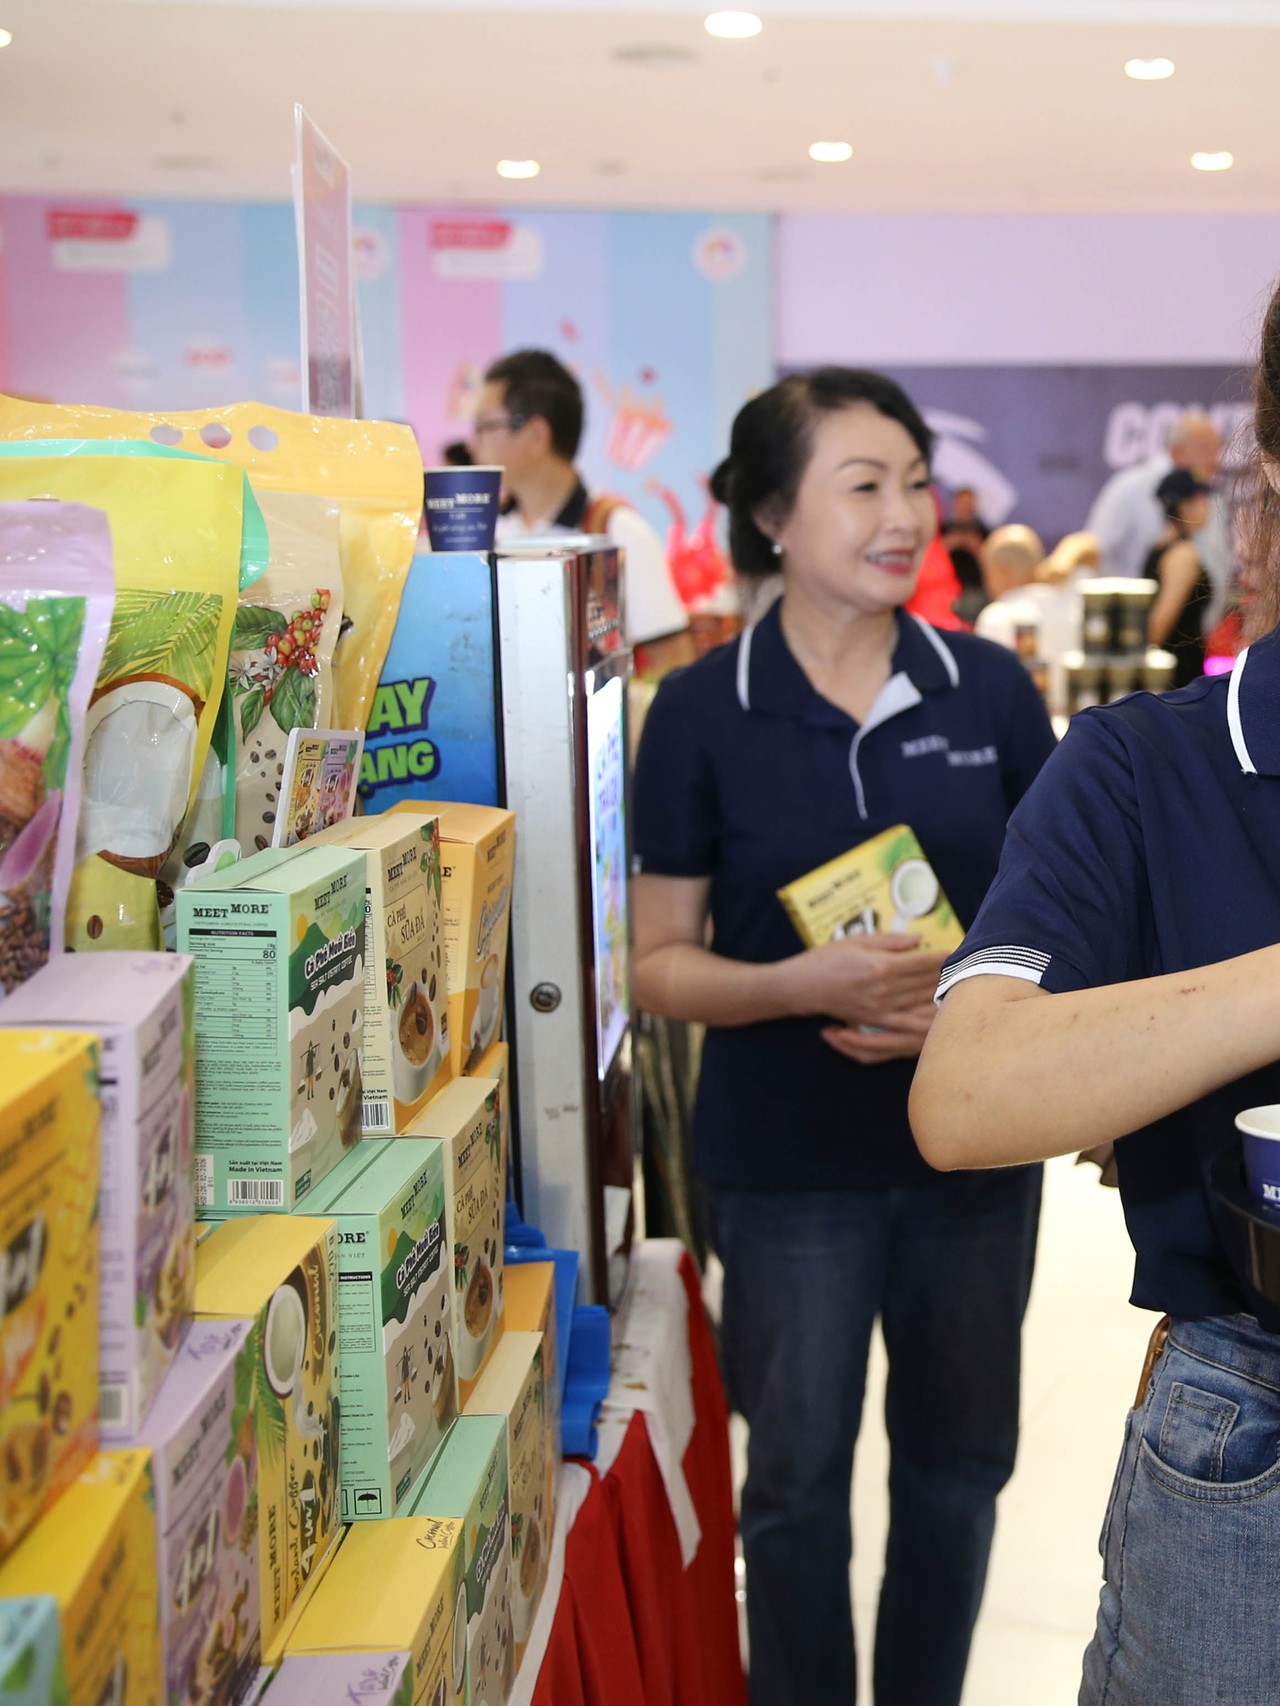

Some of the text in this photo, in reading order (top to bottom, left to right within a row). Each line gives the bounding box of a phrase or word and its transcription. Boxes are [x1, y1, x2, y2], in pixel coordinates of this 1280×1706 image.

[193, 904, 270, 918] MEET MORE
[263, 950, 276, 959] 80
[311, 1264, 325, 1360] Coconut
[268, 1503, 278, 1569] MORE
